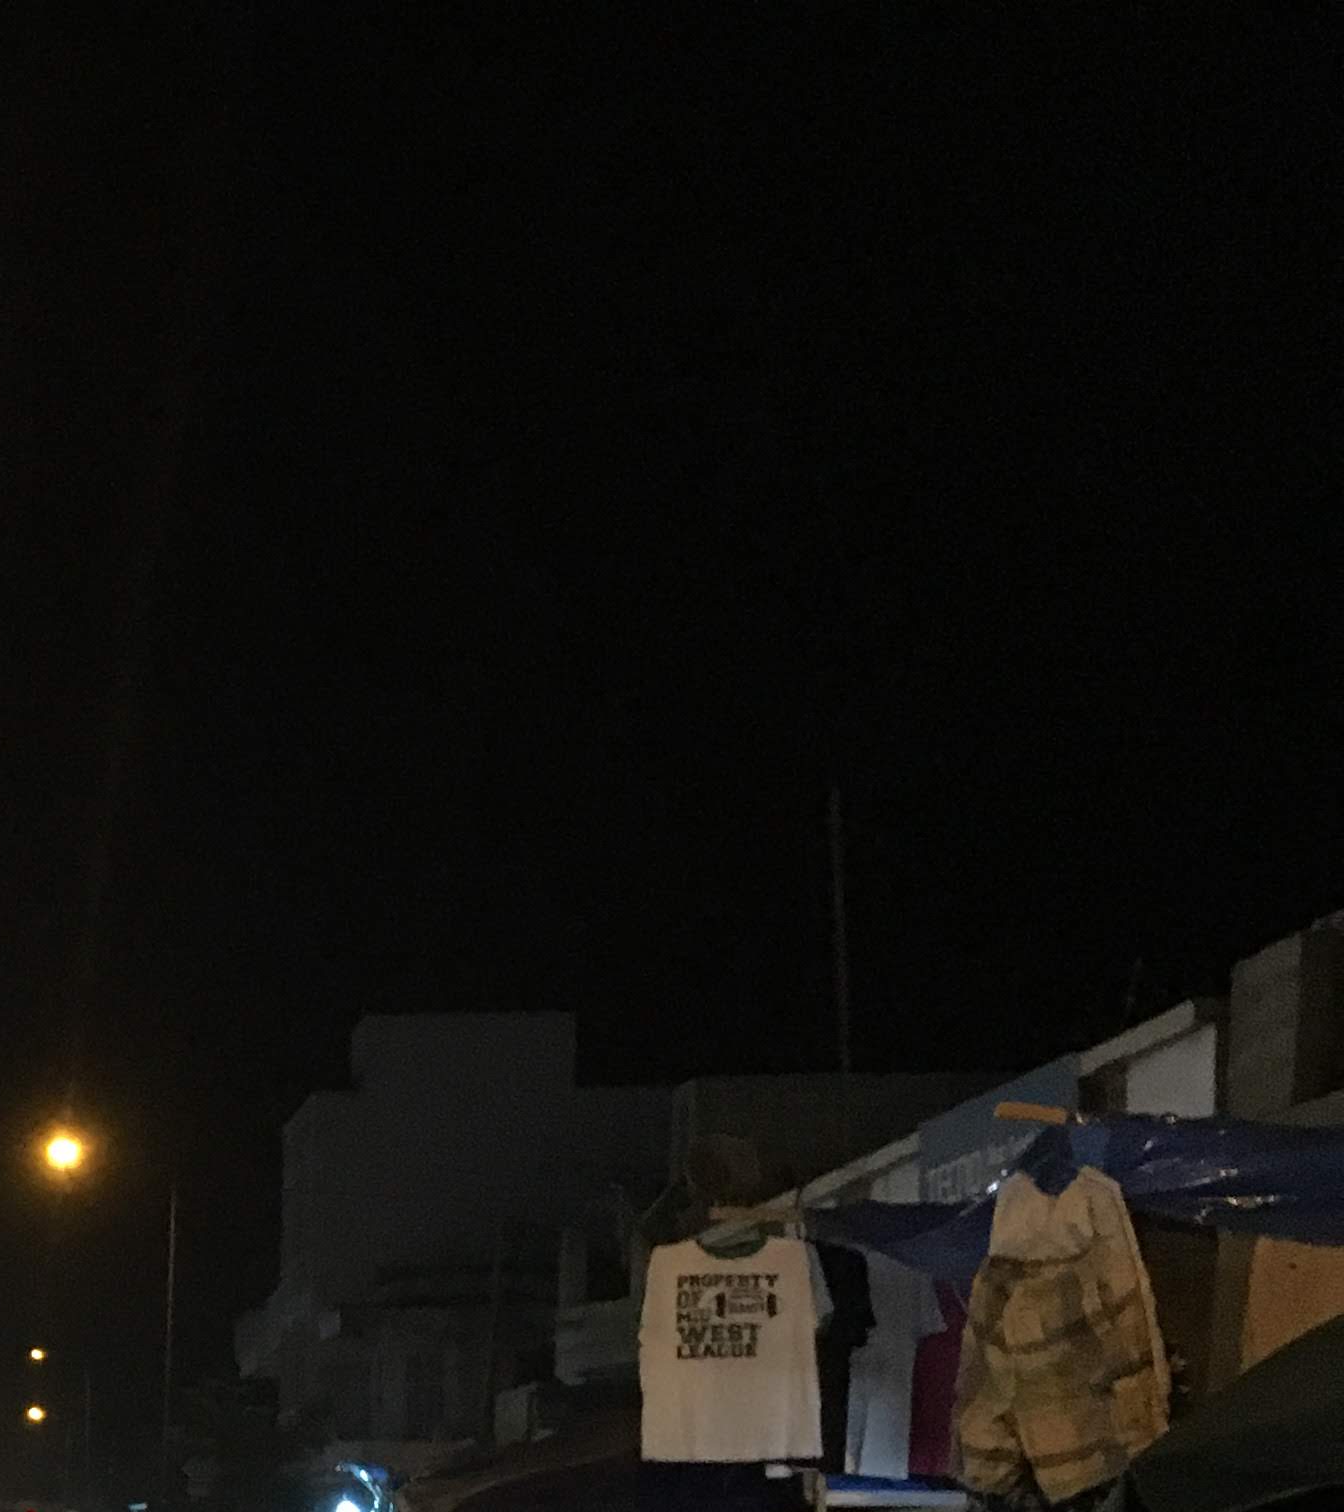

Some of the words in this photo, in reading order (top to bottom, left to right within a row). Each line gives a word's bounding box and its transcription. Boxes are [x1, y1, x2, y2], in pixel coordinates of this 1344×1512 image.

[676, 1273, 779, 1288] PROPERTY
[676, 1323, 762, 1344] WEST
[676, 1343, 758, 1360] LEAGUE
